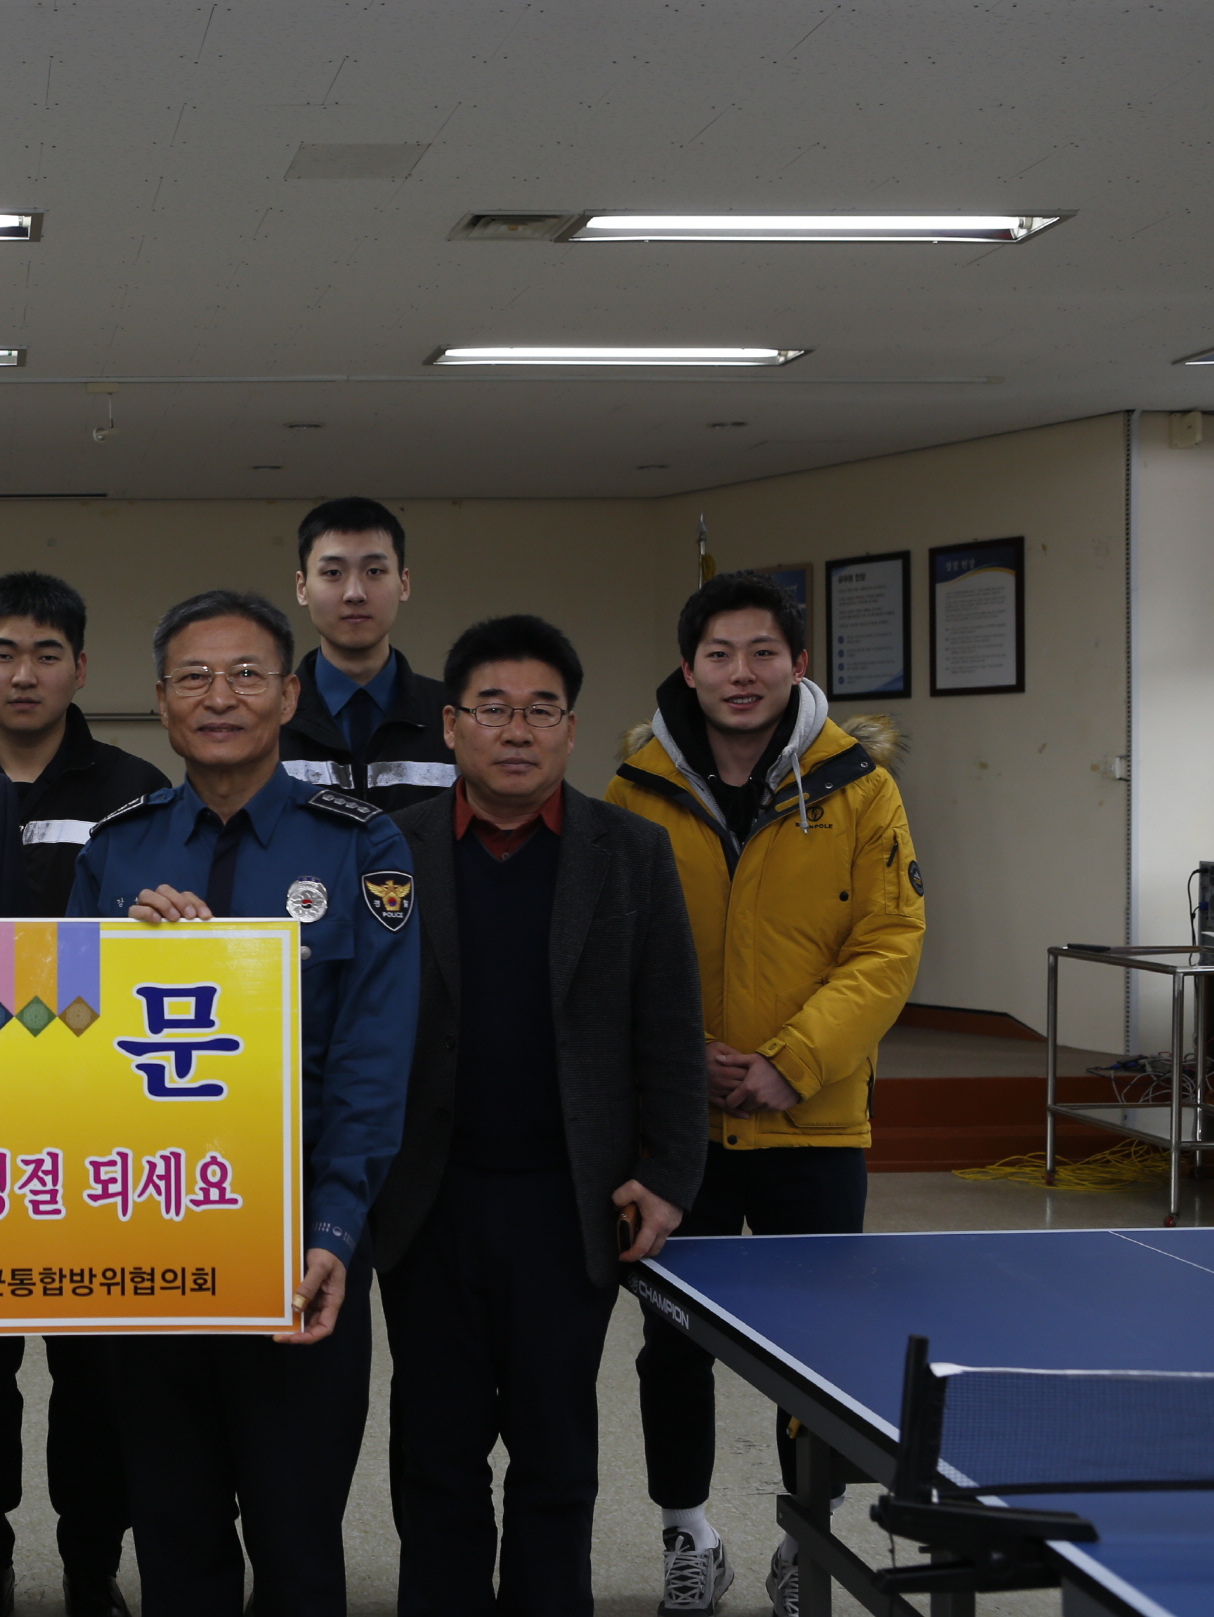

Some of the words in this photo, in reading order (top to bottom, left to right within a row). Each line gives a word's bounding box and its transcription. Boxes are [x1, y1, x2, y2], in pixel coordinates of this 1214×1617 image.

[116, 985, 241, 1099] 문
[86, 1151, 240, 1219] 되세요
[638, 1280, 689, 1330] CHAMPION
